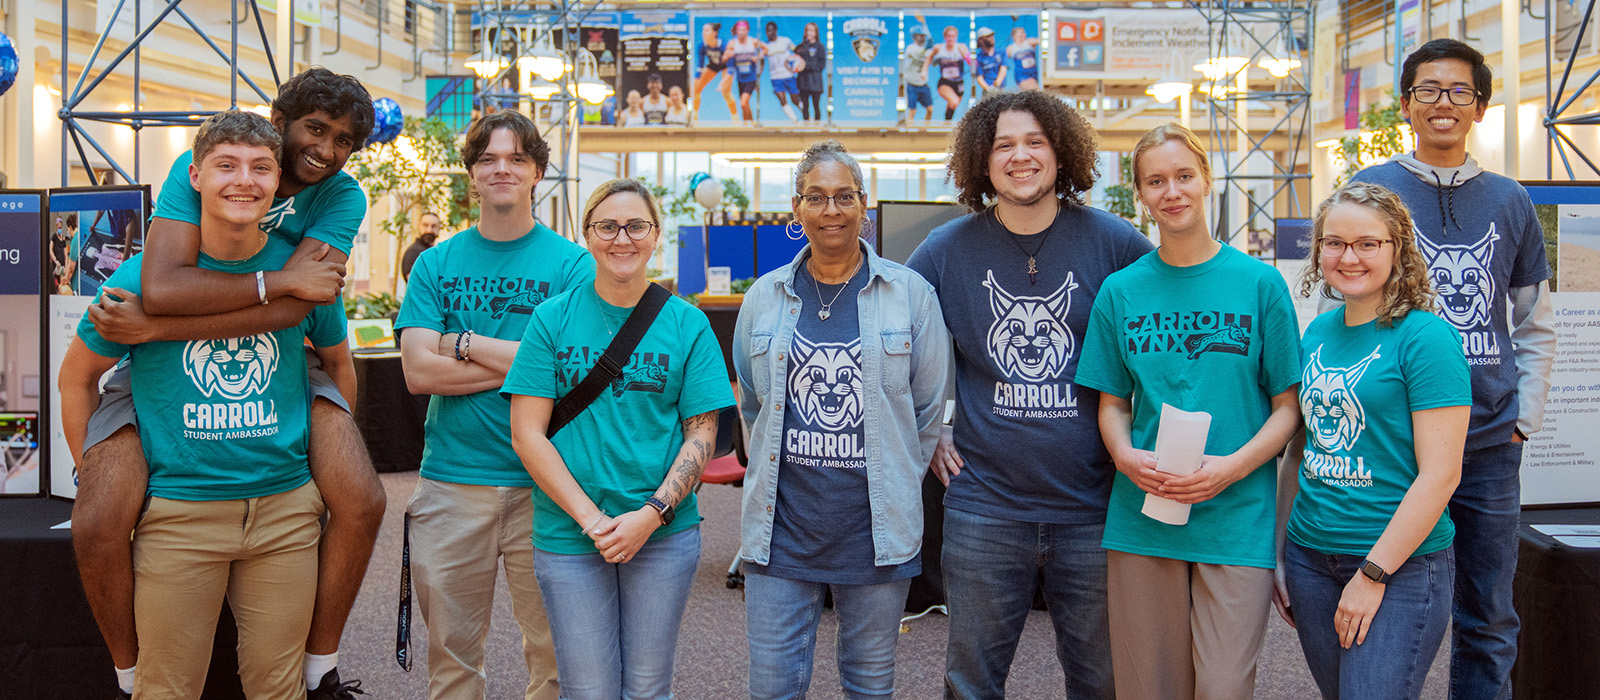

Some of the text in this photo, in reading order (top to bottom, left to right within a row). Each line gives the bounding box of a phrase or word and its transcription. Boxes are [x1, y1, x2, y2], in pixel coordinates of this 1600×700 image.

[1112, 27, 1169, 38] Emergency
[1112, 38, 1163, 48] Inclement
[882, 66, 895, 75] TO
[882, 77, 889, 85] A
[439, 276, 550, 295] CARROLL
[440, 293, 494, 312] LYNX
[1124, 311, 1252, 333] CARROLL
[1125, 334, 1190, 356] LYNX
[1460, 332, 1500, 355] ROLL
[556, 346, 670, 371] CAROLL
[994, 381, 1077, 408] CARROLL
[183, 399, 278, 429] CARROLL
[992, 407, 1078, 418] STUDENT AMBASSADOR
[184, 426, 279, 440] STUDENT AMBASSADOR
[786, 428, 866, 458] CARROL
[786, 455, 868, 468] STUDENT AMBASSAD
[1303, 449, 1371, 479] ARROLL
